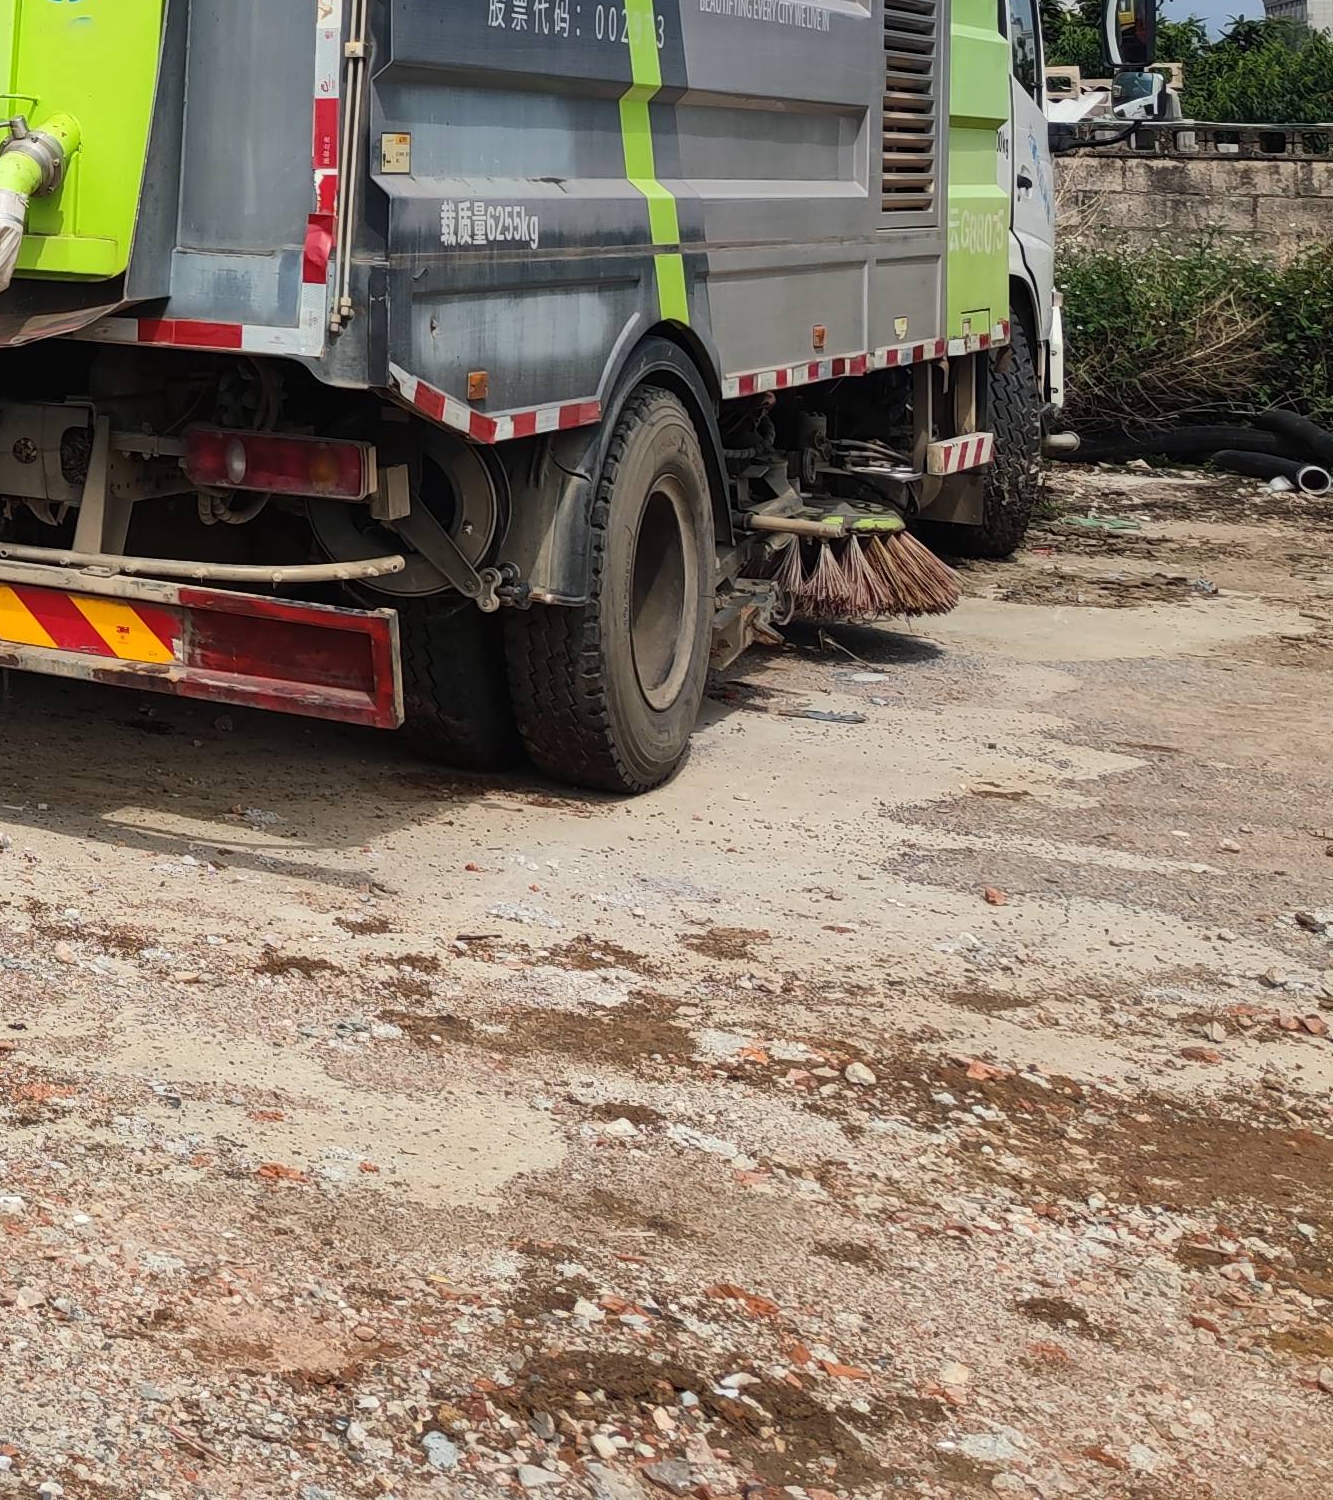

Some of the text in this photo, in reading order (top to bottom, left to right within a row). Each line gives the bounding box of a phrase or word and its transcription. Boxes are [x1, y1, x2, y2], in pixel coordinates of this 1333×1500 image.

[779, 0, 795, 25] CITY
[795, 4, 806, 28] WE
[806, 6, 821, 31] LIVE
[821, 10, 830, 32] IN
